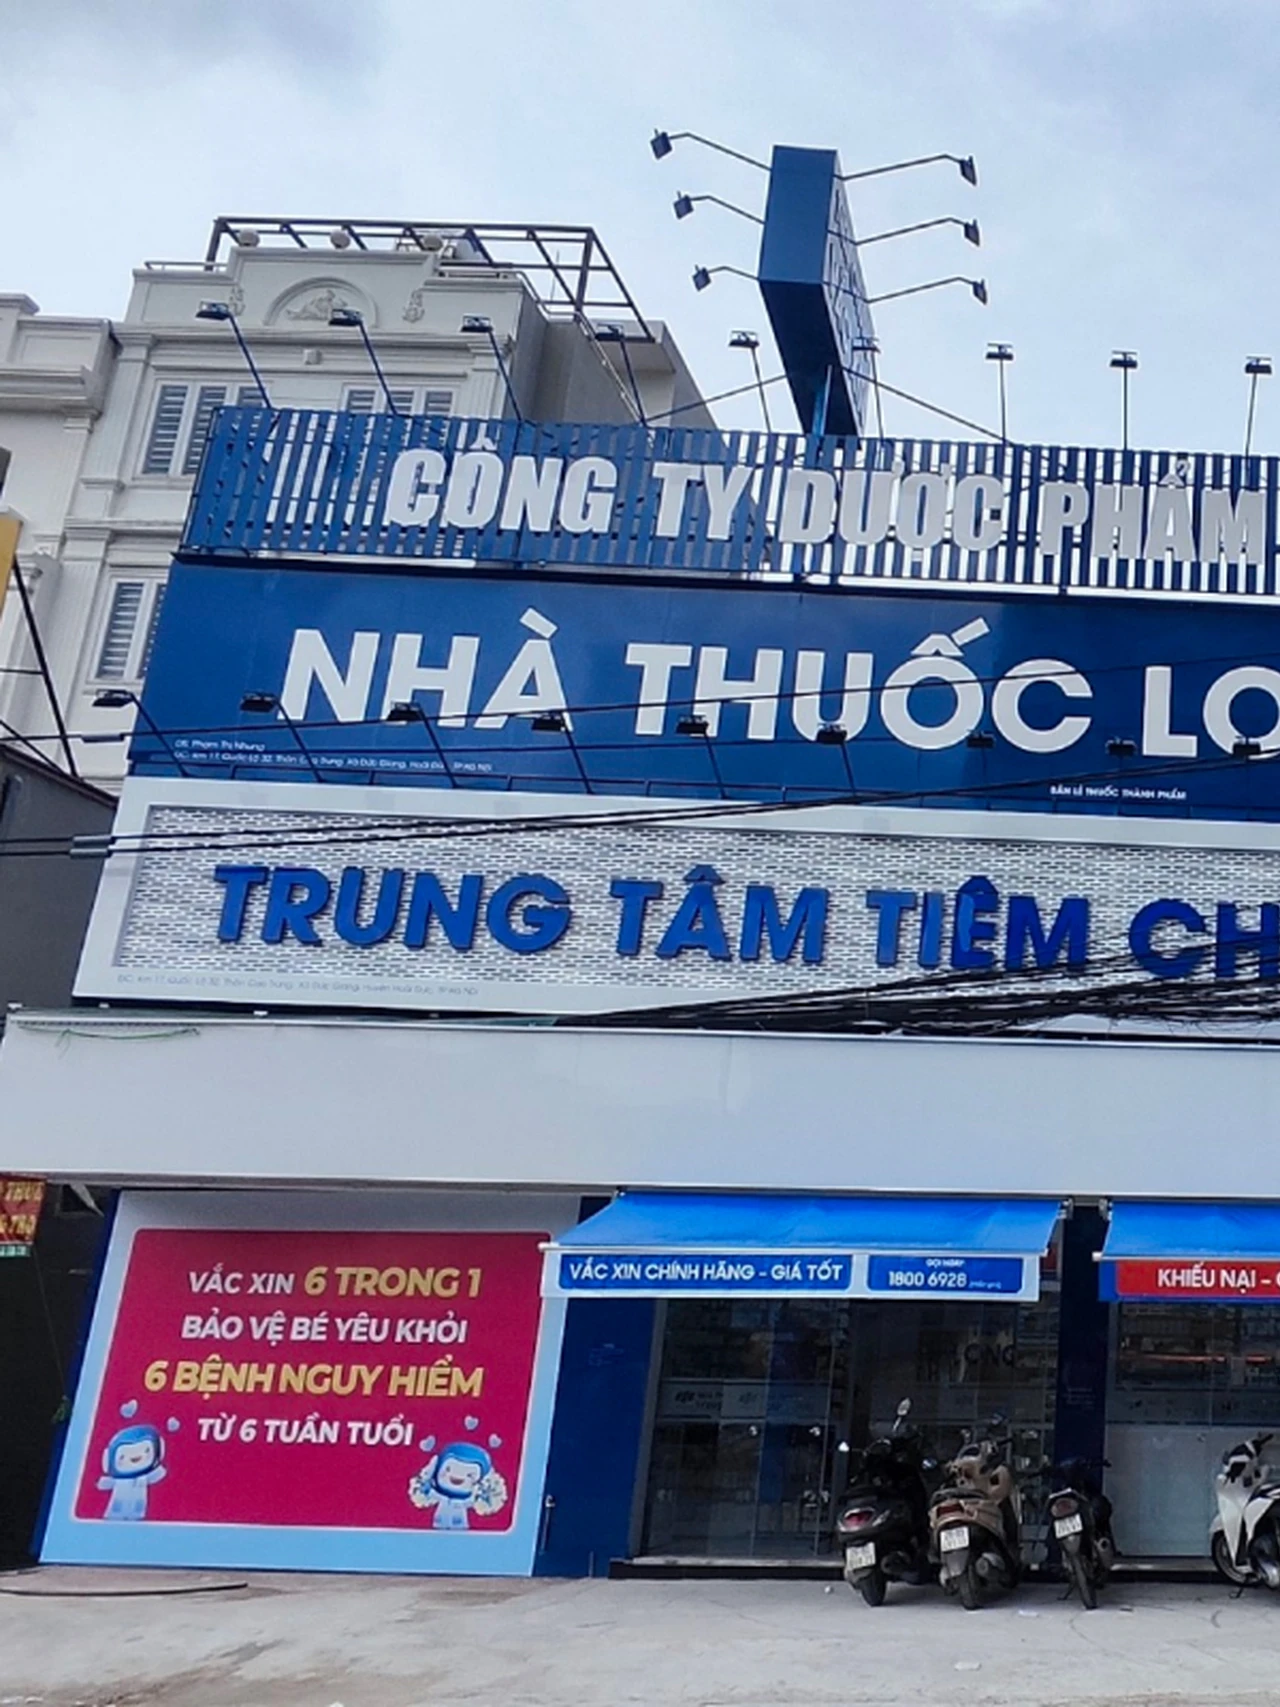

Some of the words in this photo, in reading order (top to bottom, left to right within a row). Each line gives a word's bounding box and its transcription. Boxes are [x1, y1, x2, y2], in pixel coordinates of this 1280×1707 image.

[385, 437, 617, 534] CÔNG
[653, 462, 754, 541] TY
[778, 460, 1002, 561] DƯỢC
[1039, 458, 1267, 565] PHẨM
[276, 607, 574, 733] NHÀ
[624, 617, 1094, 753] THUỐC
[213, 866, 573, 954] TRUNG
[609, 864, 831, 963] TÂM
[866, 875, 1091, 972] TIÊM
[188, 1263, 242, 1294] VẮC
[247, 1272, 294, 1295] XIN
[304, 1267, 327, 1296] 6
[335, 1267, 460, 1297] TRONG
[467, 1268, 481, 1297] 1
[569, 1257, 608, 1280] VẮC
[611, 1264, 641, 1280] XIN
[644, 1259, 700, 1280] CHÍNH
[702, 1260, 755, 1280] HÃNG
[771, 1260, 802, 1280] GIÁ
[807, 1259, 843, 1280] TỐT
[888, 1270, 925, 1287] 1800
[927, 1271, 967, 1288] 6928
[1158, 1262, 1215, 1287] KHIẾU
[1220, 1269, 1256, 1293] NẠI
[181, 1308, 243, 1340] BẢO
[250, 1310, 286, 1346] VỆ
[290, 1311, 328, 1341] BÉ
[335, 1311, 390, 1343] YÊU
[394, 1312, 467, 1344] KHỎI
[144, 1361, 168, 1392] 6
[173, 1354, 275, 1400] BỆNH
[279, 1364, 383, 1396] NGUY
[387, 1354, 484, 1397] HIỂM
[198, 1412, 236, 1442] TỪ
[239, 1418, 256, 1441] 6
[264, 1411, 339, 1444] TUẦN
[347, 1413, 415, 1447] TUỔI
